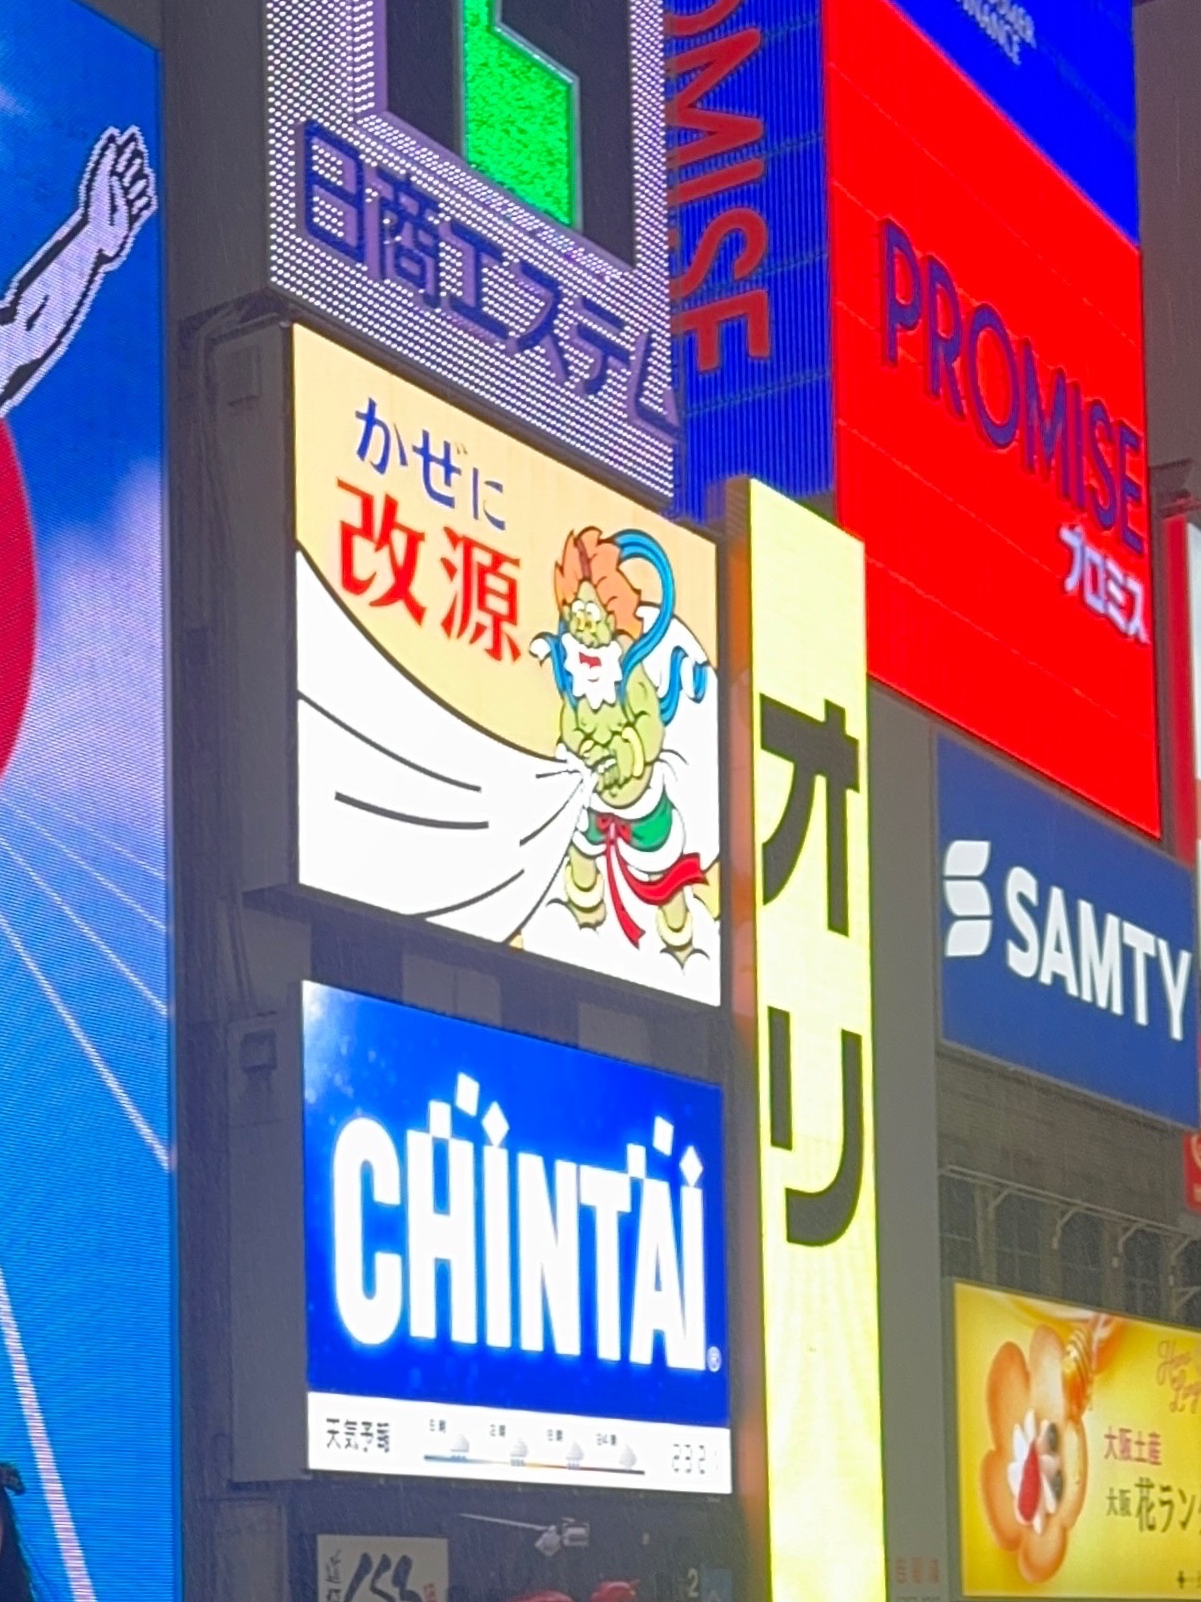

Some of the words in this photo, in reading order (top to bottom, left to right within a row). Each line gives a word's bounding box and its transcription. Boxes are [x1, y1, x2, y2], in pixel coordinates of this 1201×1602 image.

[355, 398, 507, 531] かぜに
[881, 217, 1144, 555] PROMISE
[337, 478, 522, 665] 改源
[1005, 866, 1192, 1042] SAMTY
